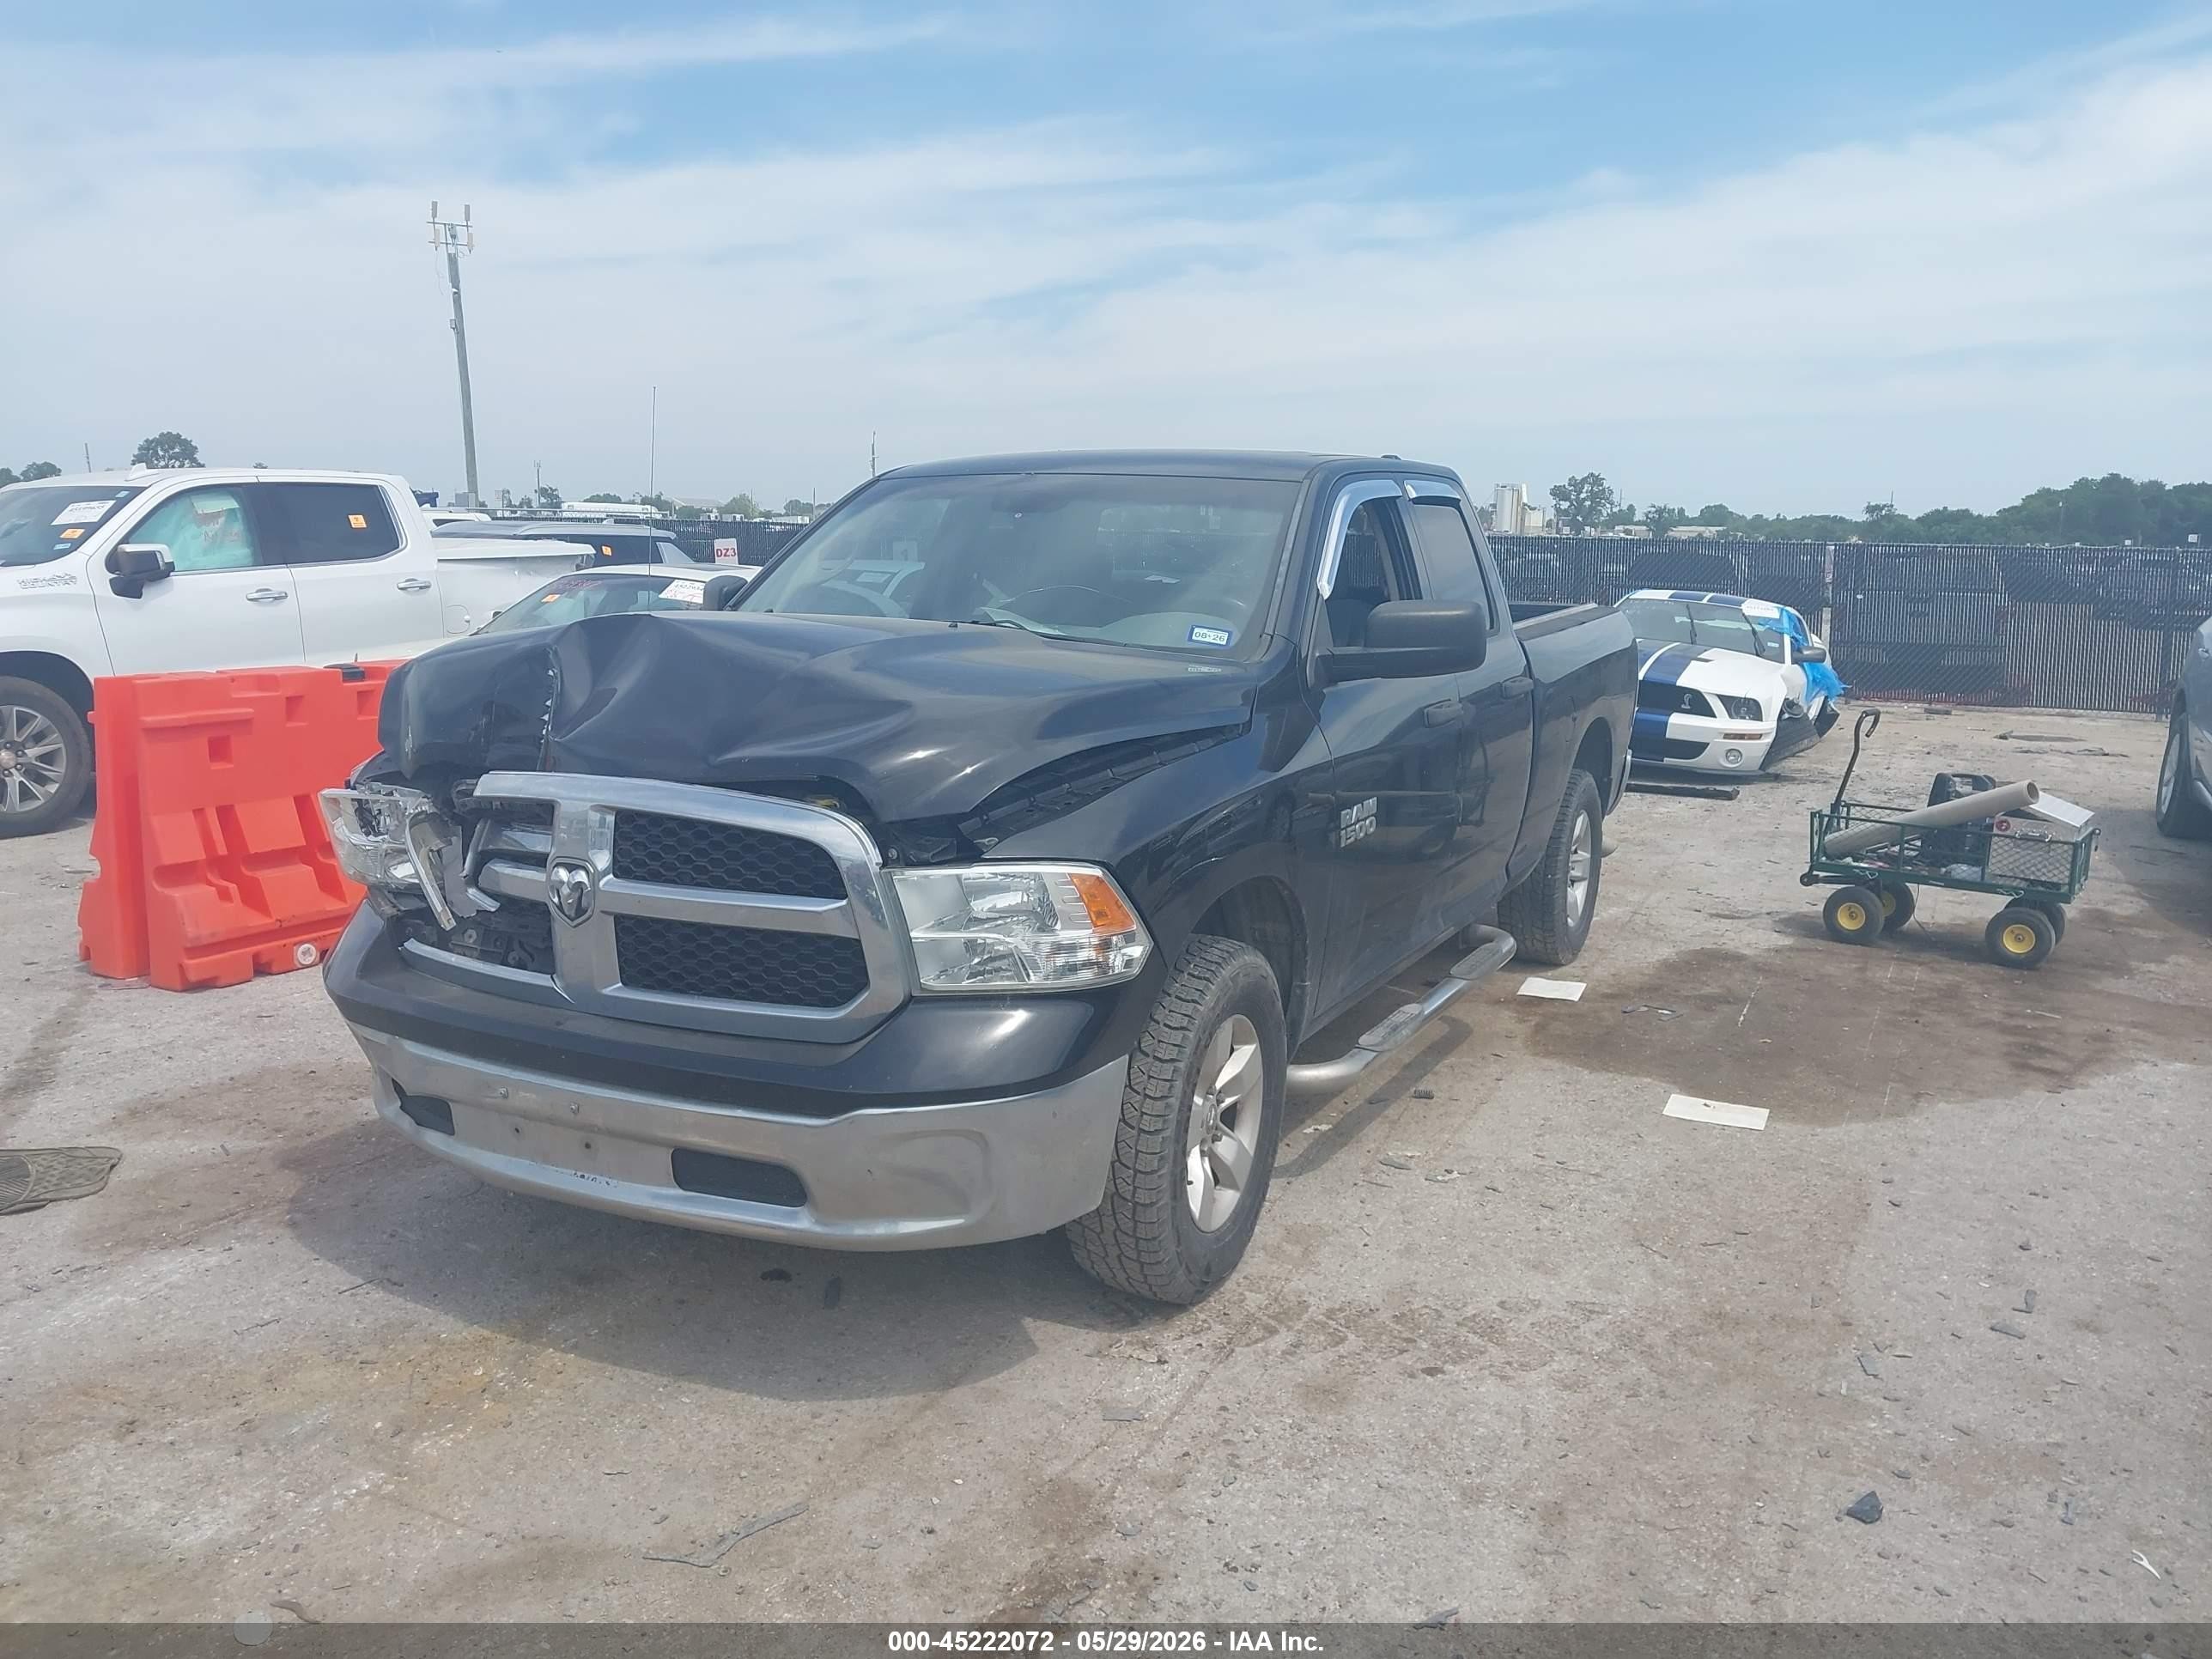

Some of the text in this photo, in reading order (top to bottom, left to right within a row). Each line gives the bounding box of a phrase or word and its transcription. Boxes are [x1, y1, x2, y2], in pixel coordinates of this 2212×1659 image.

[715, 547, 737, 557] DZ3
[1340, 797, 1377, 829] RAM
[1340, 816, 1376, 848] 1500
